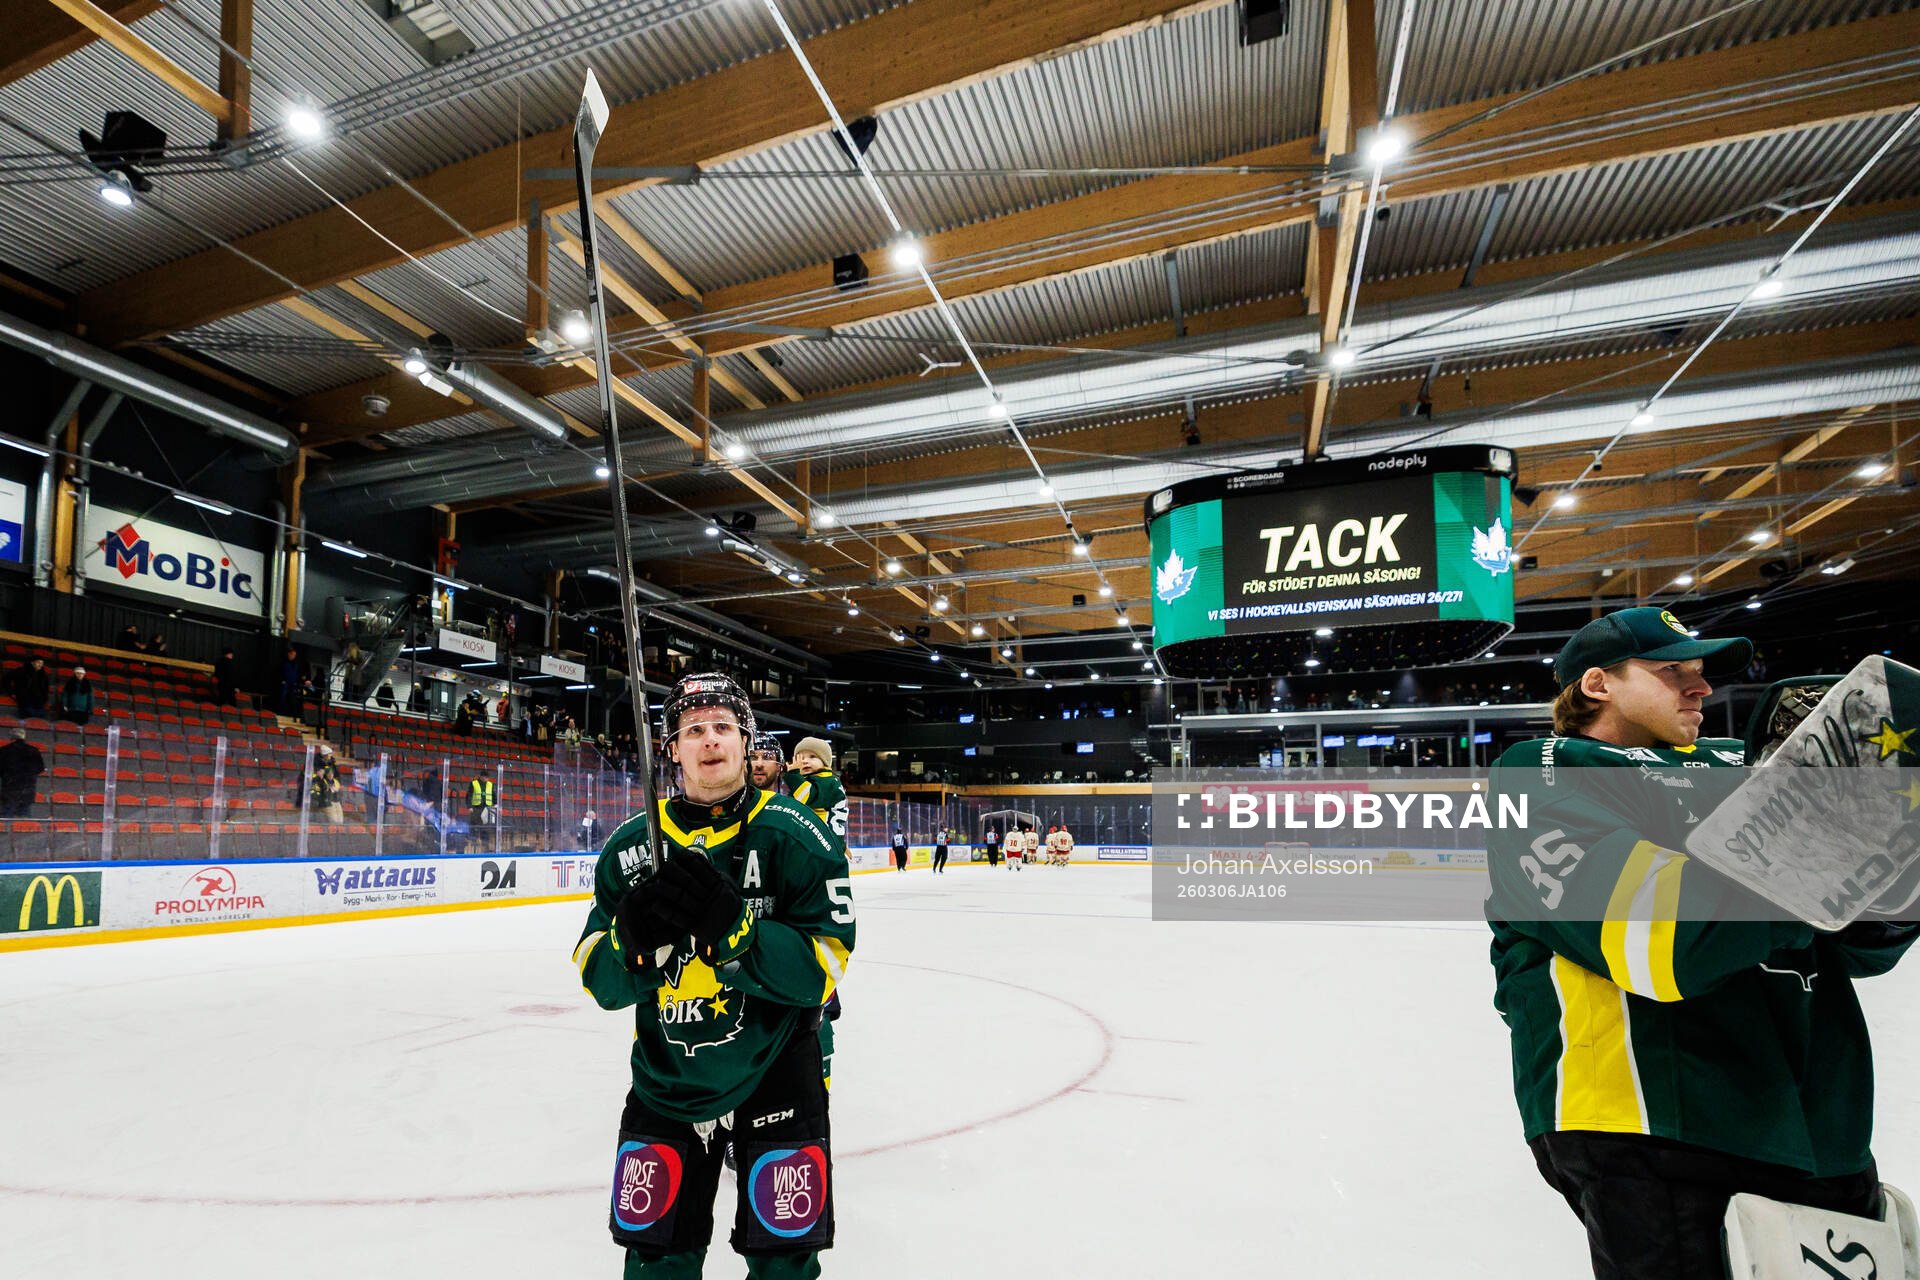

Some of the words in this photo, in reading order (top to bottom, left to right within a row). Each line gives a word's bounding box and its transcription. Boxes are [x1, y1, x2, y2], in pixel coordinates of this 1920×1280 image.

[1368, 453, 1427, 471] nodeply
[1259, 513, 1408, 574] TACK
[104, 530, 252, 599] MoBic
[1242, 579, 1266, 595] FÖR
[1268, 576, 1317, 592] STÖDET
[1317, 572, 1361, 588] DENNA
[1363, 566, 1422, 584] SÄSONG!
[1208, 610, 1218, 621] VI
[1219, 608, 1239, 620] SES
[1239, 607, 1245, 618] I
[1245, 598, 1362, 618] HOCKEYALLSVENSKAN
[1363, 593, 1426, 608] SÄSONGEN
[1427, 591, 1464, 603] 26/27!
[462, 639, 486, 653] KIOSK
[558, 664, 577, 676] KIOSK
[344, 866, 437, 890] attacus
[743, 850, 761, 889] A
[155, 896, 265, 915] PROLYMPIA
[663, 995, 705, 1024] ÖIK
[752, 1108, 794, 1128] CCM
